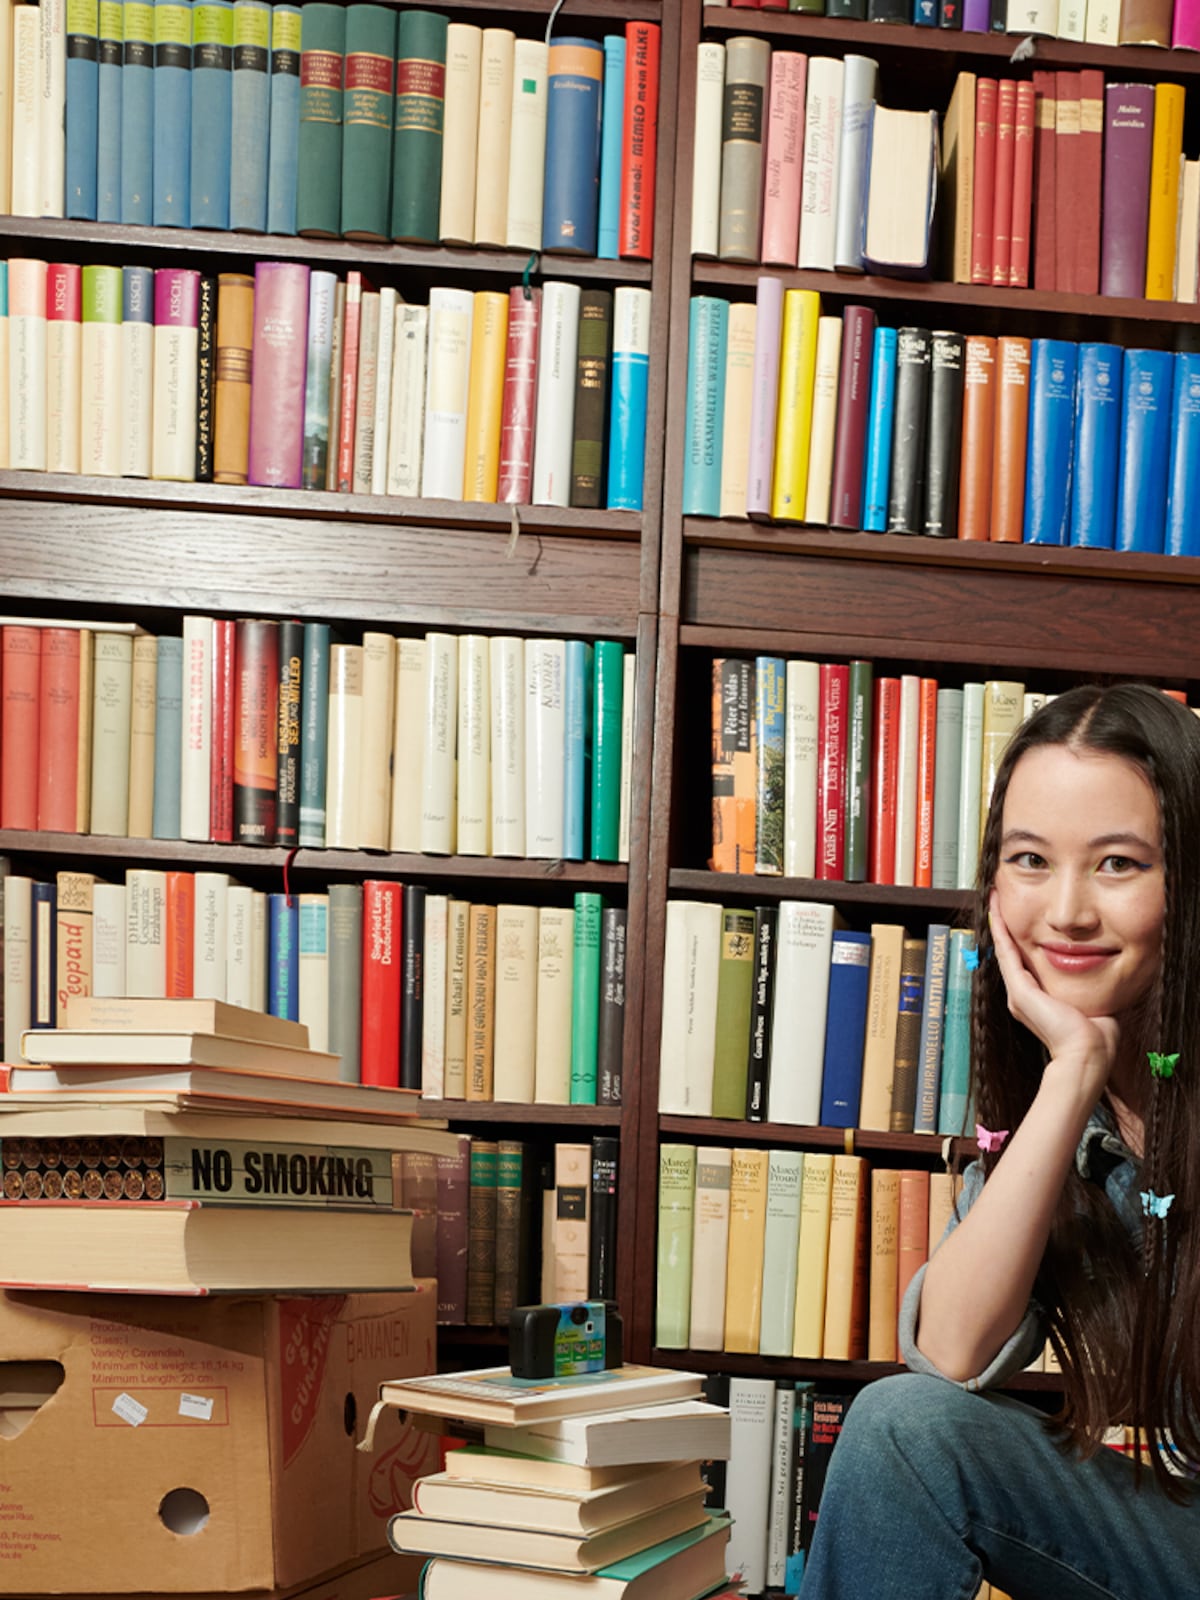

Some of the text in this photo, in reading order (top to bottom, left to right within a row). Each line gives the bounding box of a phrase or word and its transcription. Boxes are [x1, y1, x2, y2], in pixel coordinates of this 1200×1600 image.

[632, 27, 648, 157] MEMED FALKE
[55, 273, 67, 312] KISCH
[131, 274, 142, 314] KISCH
[170, 279, 182, 319] KISCH
[691, 402, 704, 466] CHRISTIAN
[703, 386, 717, 467] GESAMMELTE
[188, 638, 205, 751] KARL KRAUS
[279, 684, 290, 754] EINSAMKEIT
[288, 657, 301, 745] SEX MITLEID
[724, 707, 738, 736] Péter
[827, 677, 841, 791] Das Delta der Venus
[279, 768, 288, 803] HELMUT
[287, 757, 296, 804] KRAUSSER
[826, 808, 838, 832] Nin
[371, 890, 382, 961] Siegfried Lenz
[382, 890, 393, 965] Deutschstunde
[205, 948, 213, 962] Die
[922, 933, 946, 1124] LUIGI PIRANDELLO MATTIA PASCAL
[192, 1148, 374, 1199] NO SMOKING
[131, 1348, 185, 1358] Cavendish
[346, 1319, 411, 1363] BANANEN
[140, 1361, 157, 1371] Net
